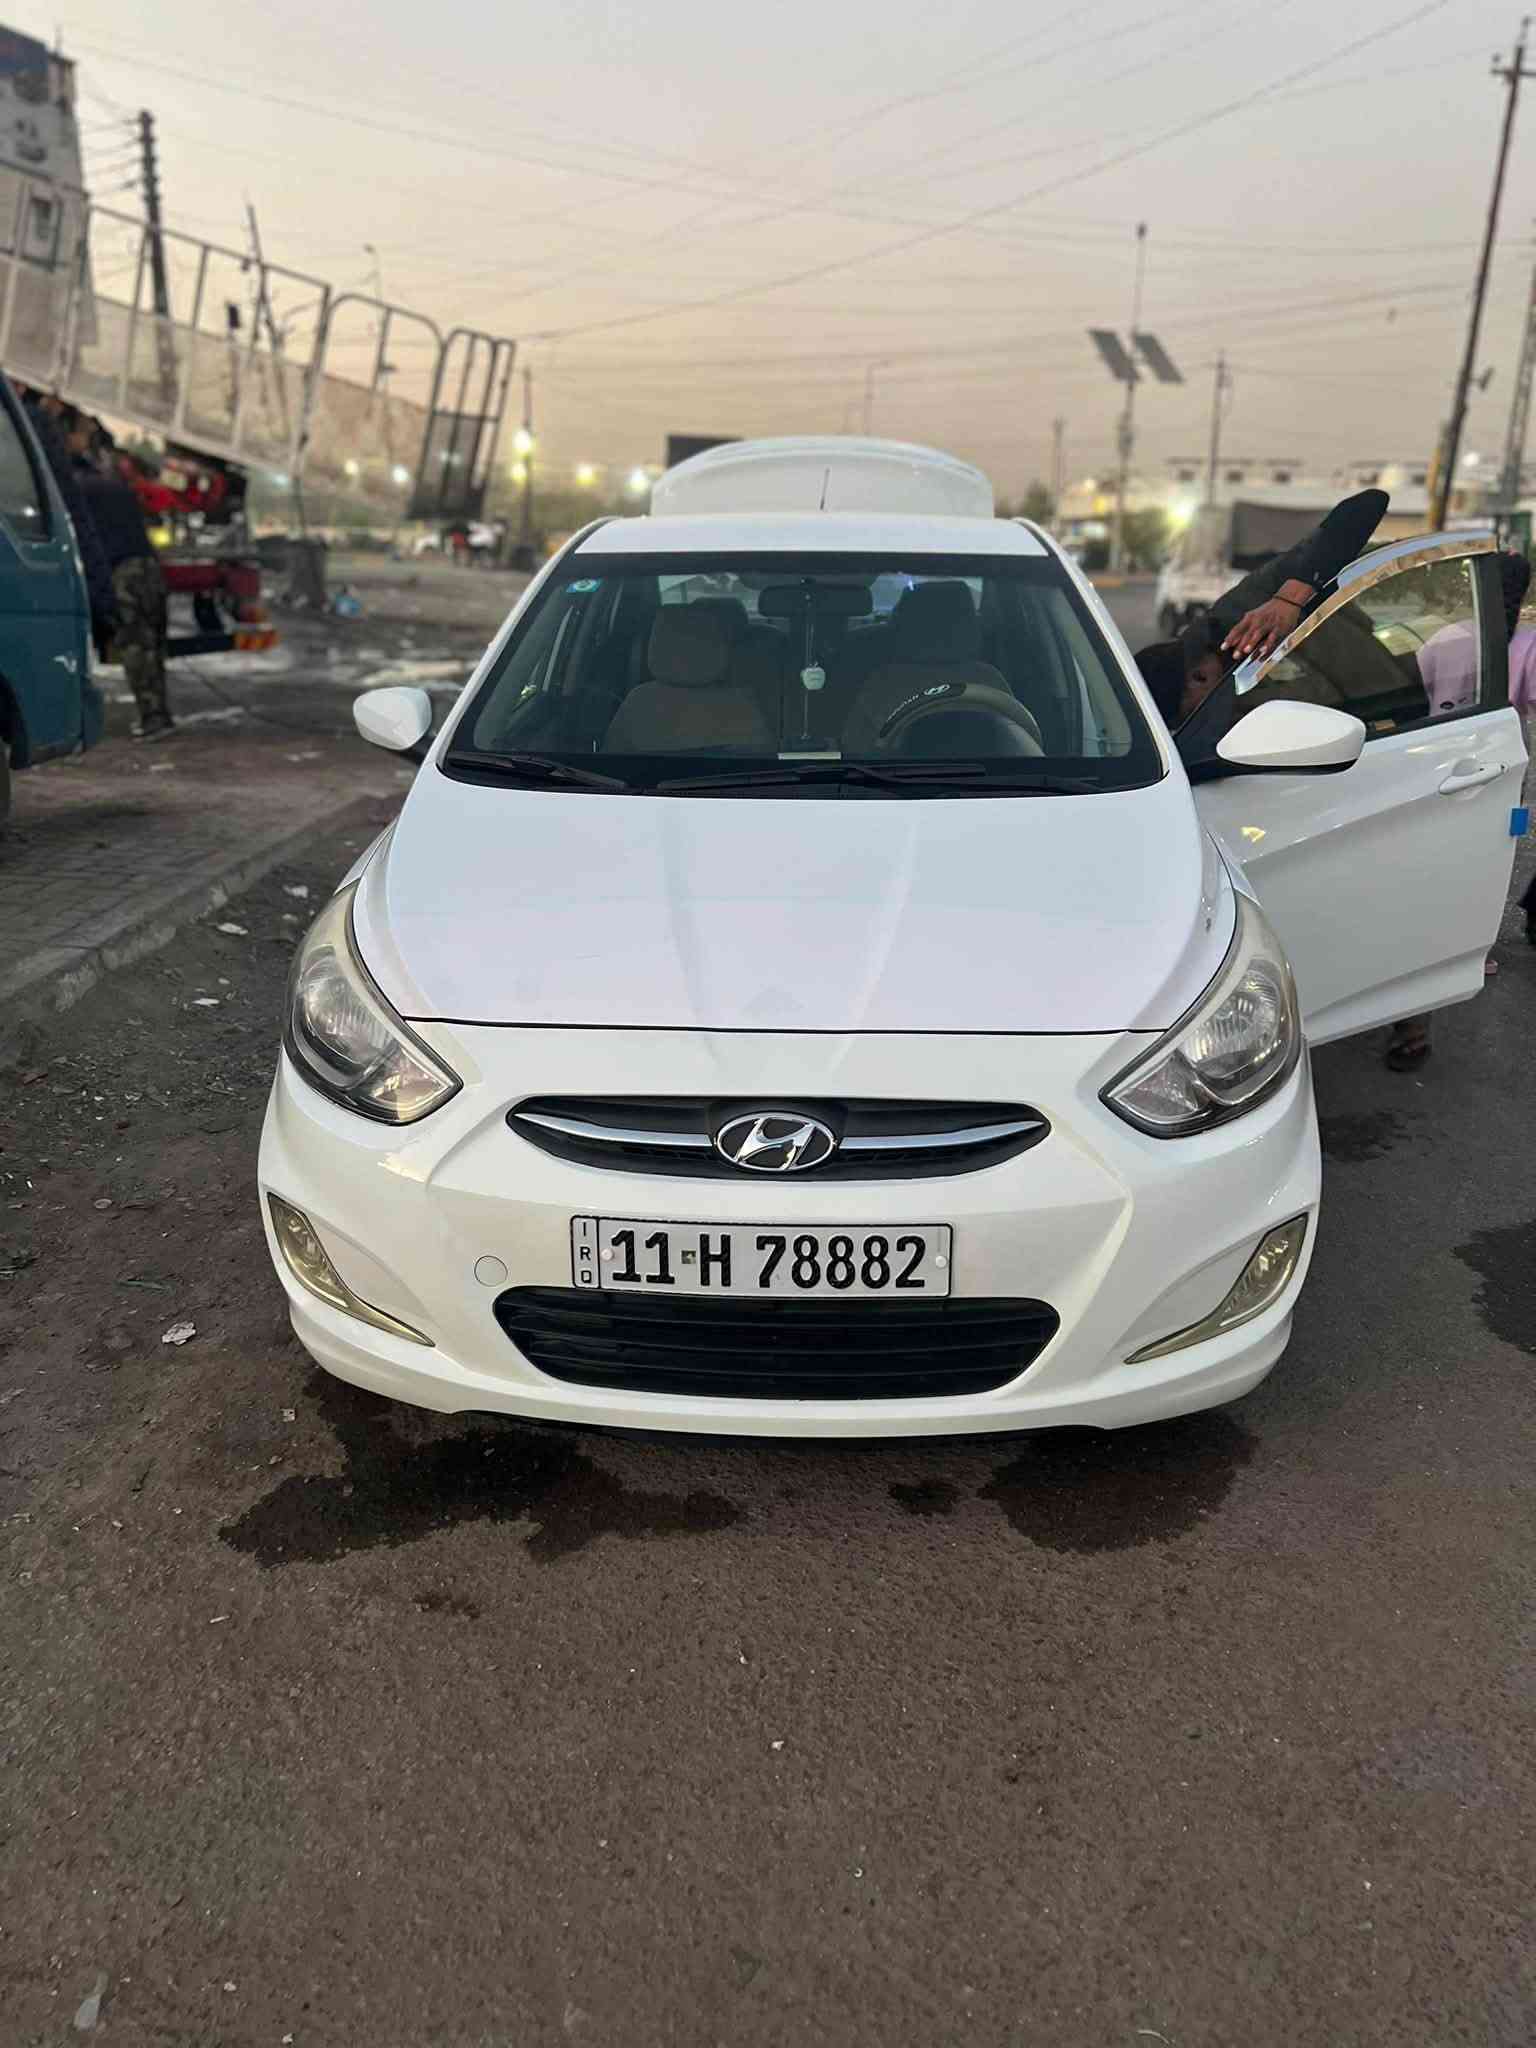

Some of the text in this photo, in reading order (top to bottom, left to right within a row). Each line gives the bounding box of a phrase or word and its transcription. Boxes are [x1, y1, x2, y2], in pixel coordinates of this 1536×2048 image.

[611, 1229, 927, 1290] 11 H 78882
